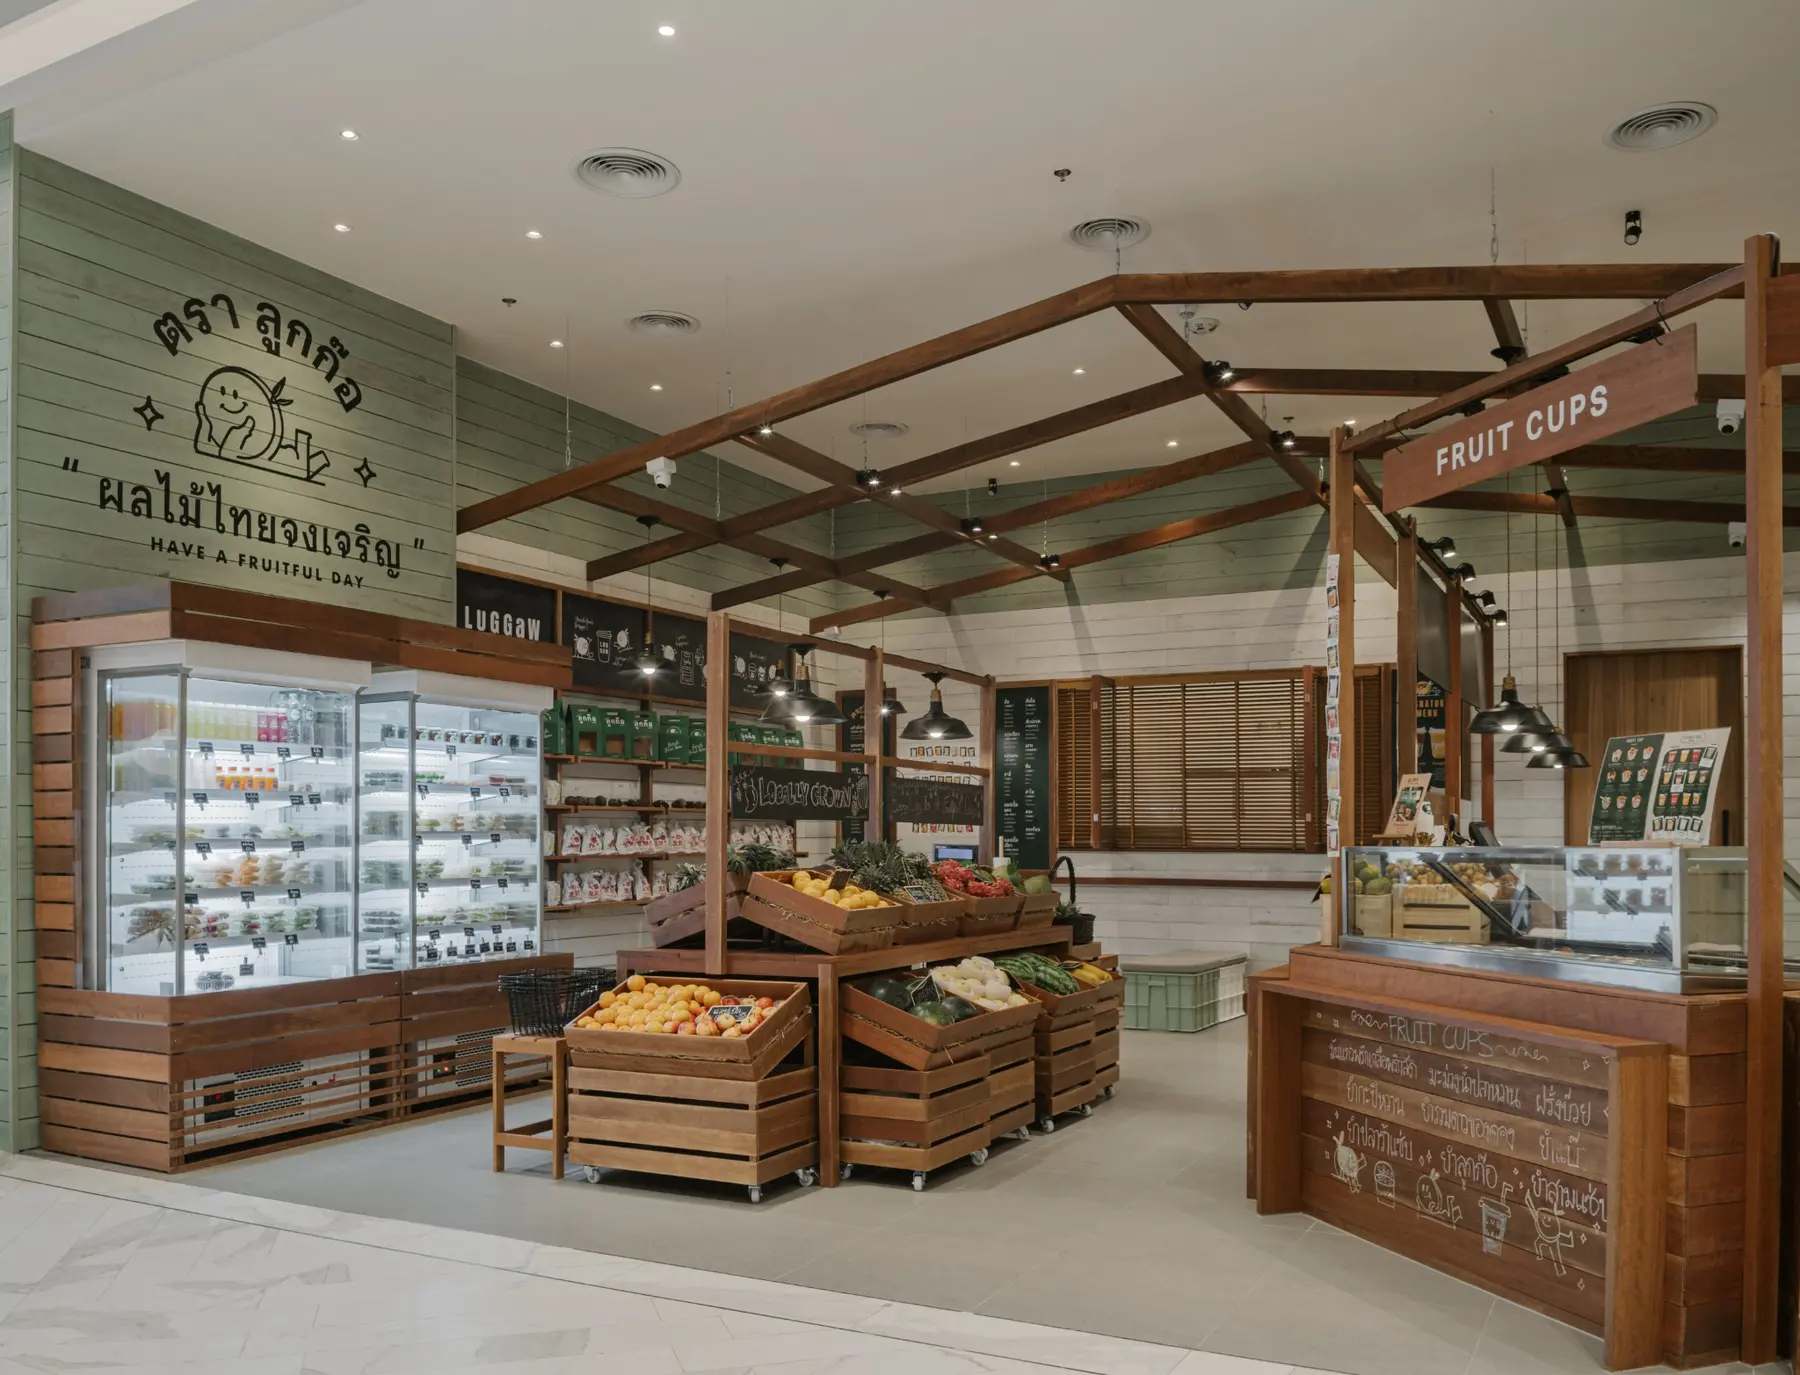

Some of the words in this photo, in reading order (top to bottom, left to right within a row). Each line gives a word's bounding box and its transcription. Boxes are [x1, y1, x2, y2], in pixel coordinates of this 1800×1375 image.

[152, 292, 241, 357] ตรา
[1435, 420, 1515, 477] FRUIT
[1525, 384, 1609, 441] CUPS
[150, 536, 206, 562] HAVE
[215, 548, 228, 565] A
[238, 554, 325, 583] FRUITFUL
[331, 571, 366, 590] DAY
[758, 776, 810, 807] LOCALLY
[810, 783, 852, 809] GROWN
[1388, 1015, 1436, 1047] FRUIT
[1442, 1023, 1495, 1057] CUPS
[1428, 1064, 1522, 1110] มะม่วงน้ำปลาหวาน
[1535, 1083, 1591, 1126] ฝรั่งบ๊วย
